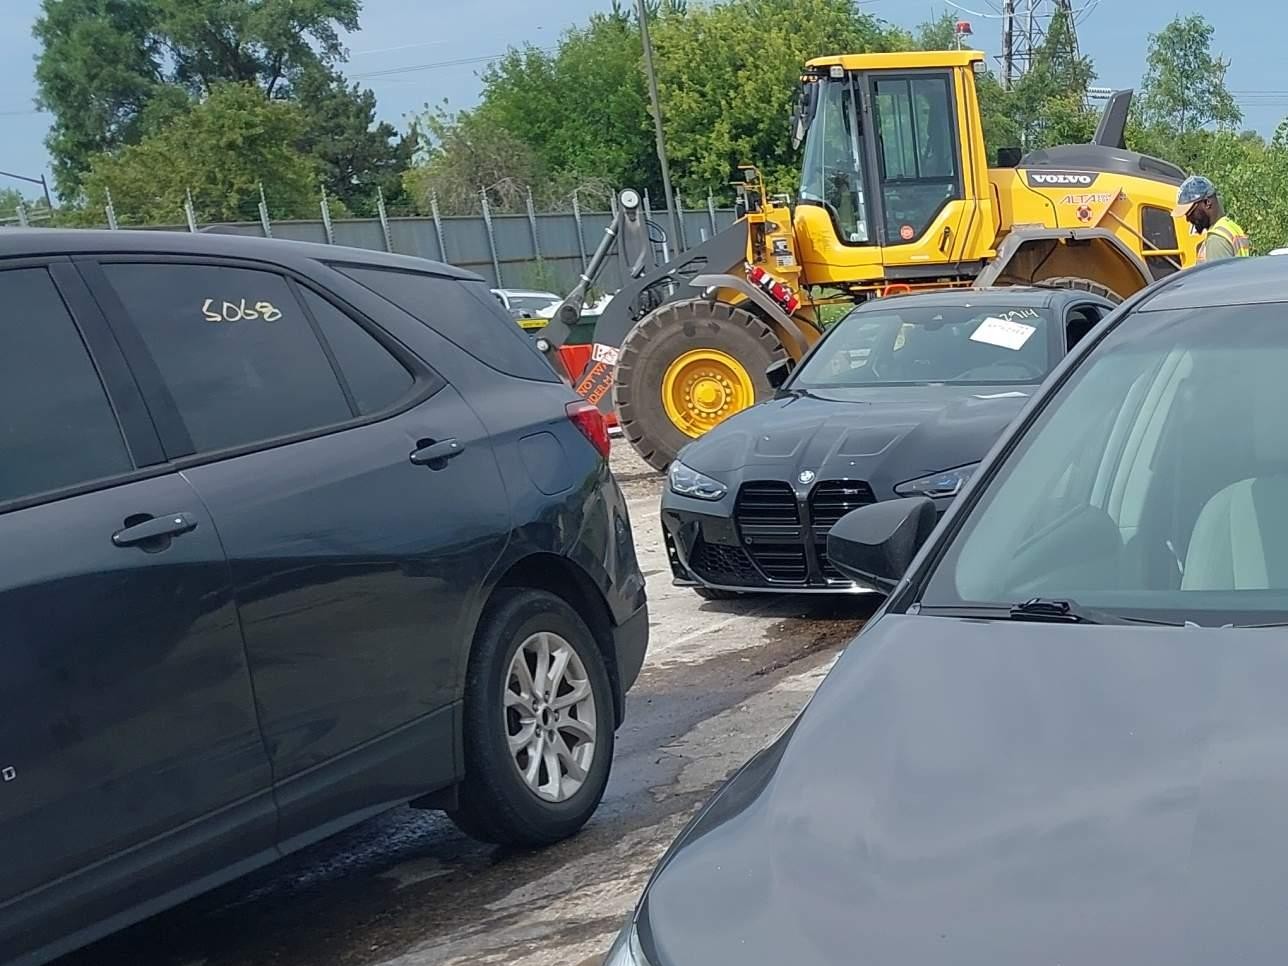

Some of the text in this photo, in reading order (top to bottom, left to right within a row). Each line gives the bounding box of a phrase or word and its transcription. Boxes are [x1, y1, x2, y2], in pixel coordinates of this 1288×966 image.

[1031, 174, 1091, 184] VOLVO
[1060, 194, 1096, 205] ALTA
[202, 298, 282, 322] 5068
